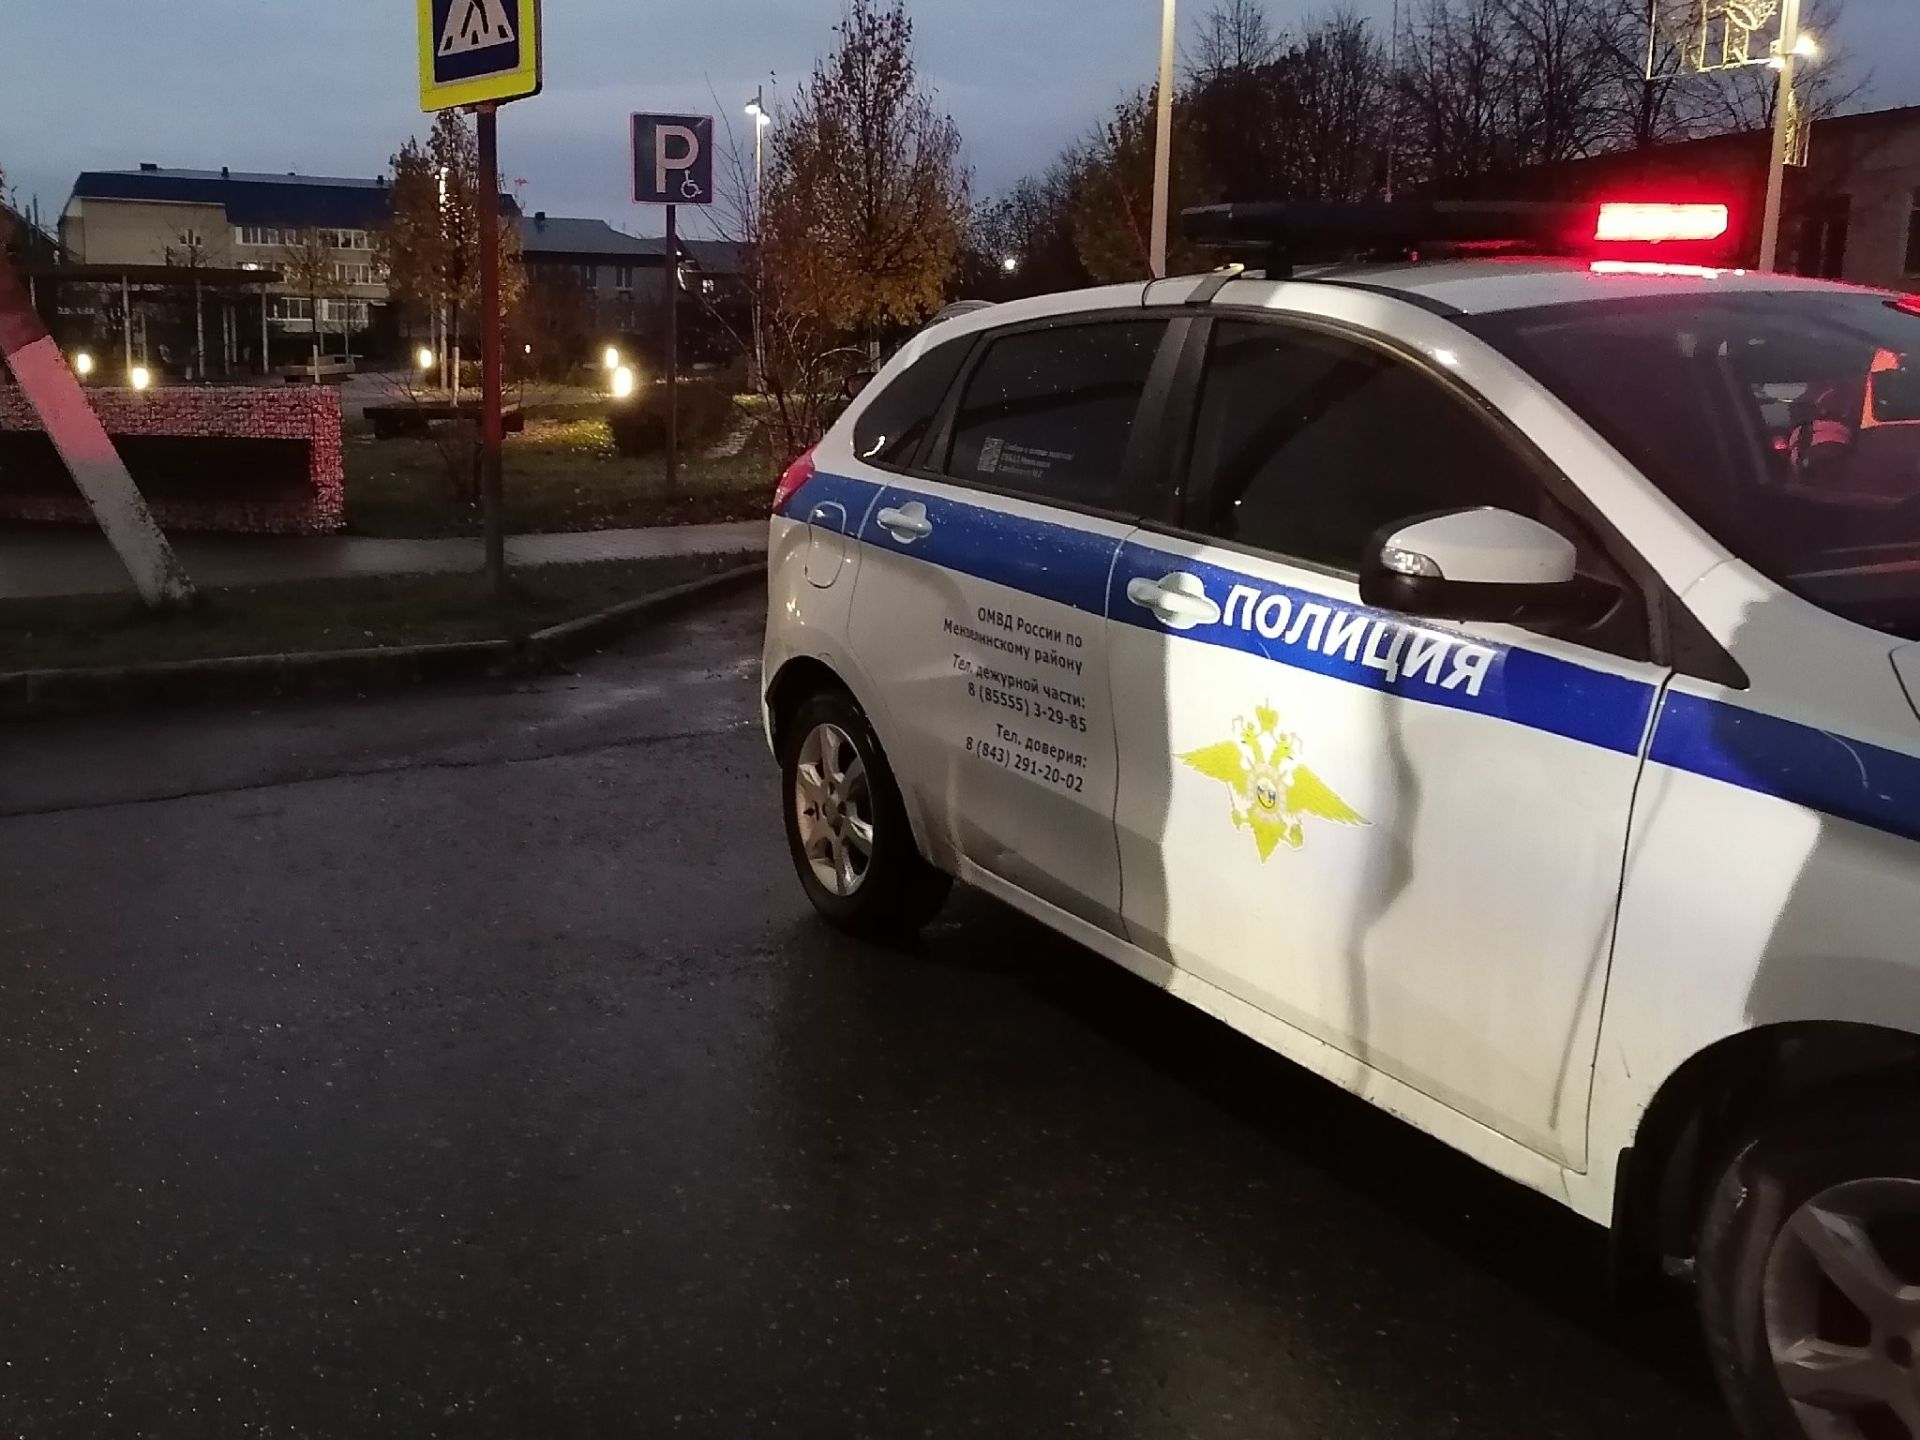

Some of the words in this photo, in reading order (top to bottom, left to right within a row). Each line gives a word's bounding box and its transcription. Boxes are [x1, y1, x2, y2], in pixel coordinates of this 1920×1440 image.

[655, 124, 699, 193] P
[977, 607, 1013, 632] ОМВД
[1016, 616, 1062, 643] России
[1066, 633, 1083, 649] по
[1223, 584, 1497, 697] ПОЛИЦИЯ
[952, 653, 974, 674] Тел.
[975, 664, 1039, 694] дежурной
[1042, 684, 1086, 709] части:
[1034, 650, 1083, 676] району
[968, 682, 976, 698] 8
[979, 686, 1030, 718] (85555)
[1034, 701, 1088, 733] 3-29-85
[965, 736, 973, 752] 8
[976, 739, 1010, 768] (843)
[1014, 753, 1084, 793] 291-20-02
[996, 723, 1021, 746] Тел.
[1024, 736, 1087, 769] доверия:
